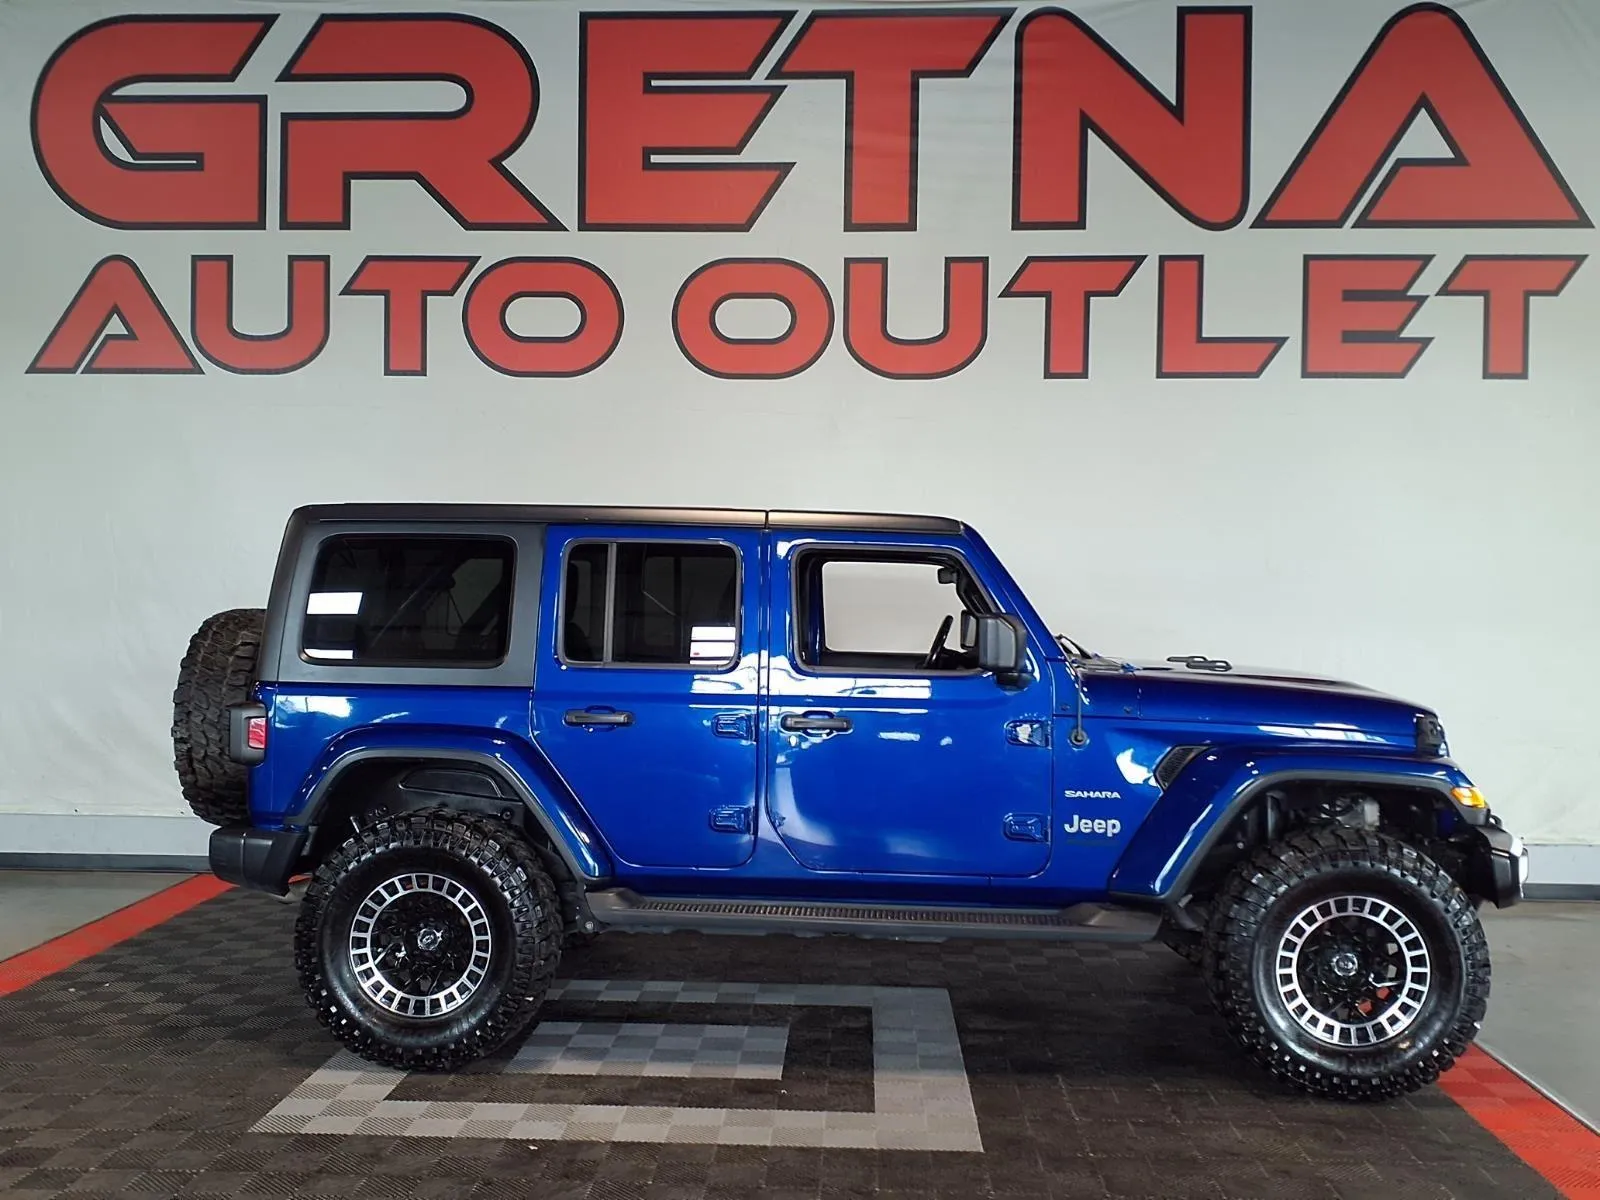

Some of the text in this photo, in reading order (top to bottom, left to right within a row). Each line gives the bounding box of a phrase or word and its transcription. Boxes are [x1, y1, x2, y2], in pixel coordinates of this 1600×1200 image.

[30, 2, 1595, 232] GRETNA
[25, 254, 1588, 379] AUTO OUTLET
[1064, 790, 1121, 799] SAHARA
[1064, 814, 1121, 837] Jeep
